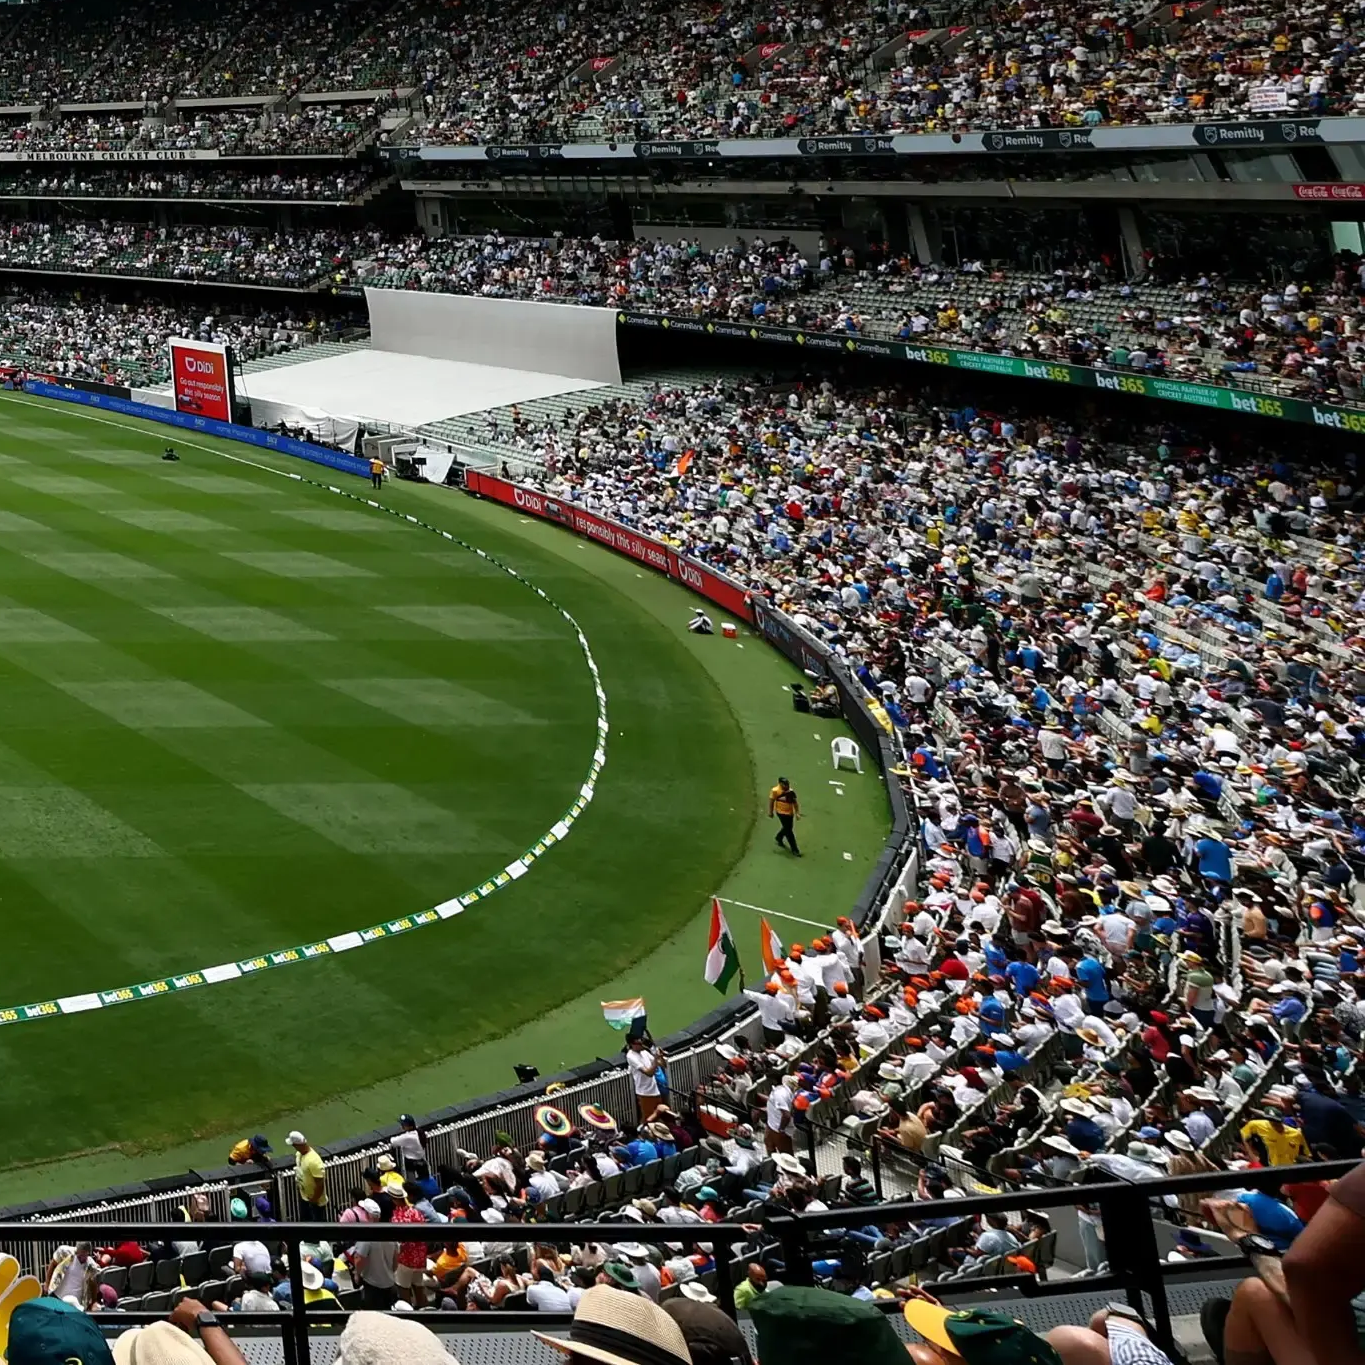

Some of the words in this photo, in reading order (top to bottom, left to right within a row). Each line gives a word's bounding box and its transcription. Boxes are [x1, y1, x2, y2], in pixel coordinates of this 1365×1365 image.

[1219, 127, 1265, 141] Remitly
[818, 140, 852, 152] Remitly
[1005, 136, 1044, 148] Remitly
[27, 152, 95, 161] MELBOURNE
[102, 151, 149, 160] CRICKET
[156, 151, 186, 160] CLUB
[501, 147, 529, 157] Remitly
[651, 145, 682, 155] Remitly
[1298, 185, 1329, 198] Coca-Cola
[1331, 185, 1363, 198] Coca-Cola
[626, 317, 658, 327] CommBank
[670, 320, 703, 331] CommBank
[758, 330, 793, 342] CommBank
[805, 335, 842, 348] CommBank
[856, 342, 890, 354] CommBank
[905, 346, 949, 364] bet365
[197, 360, 214, 374] DiDi
[1024, 361, 1070, 382] bet365
[180, 376, 187, 385] Go
[188, 378, 196, 386] out
[196, 379, 224, 394] responsibly
[1095, 372, 1145, 394] bet365
[1153, 380, 1177, 391] OFFICIAL
[1179, 383, 1207, 395] PARTNER
[1208, 388, 1218, 397] OF
[184, 387, 193, 396] this
[203, 391, 221, 402] season
[1157, 389, 1181, 400] CRICKET
[1183, 392, 1218, 405] AUSTRALIA
[1230, 392, 1283, 417] bet365
[1312, 406, 1365, 434] bet365
[525, 495, 542, 512] DiDi
[576, 515, 615, 546] responsibly
[616, 532, 630, 550] this
[631, 540, 645, 560] silly
[238, 957, 268, 972] bet365
[172, 972, 203, 988] bet365
[101, 988, 134, 1004] bet365
[24, 1001, 58, 1017] bet365
